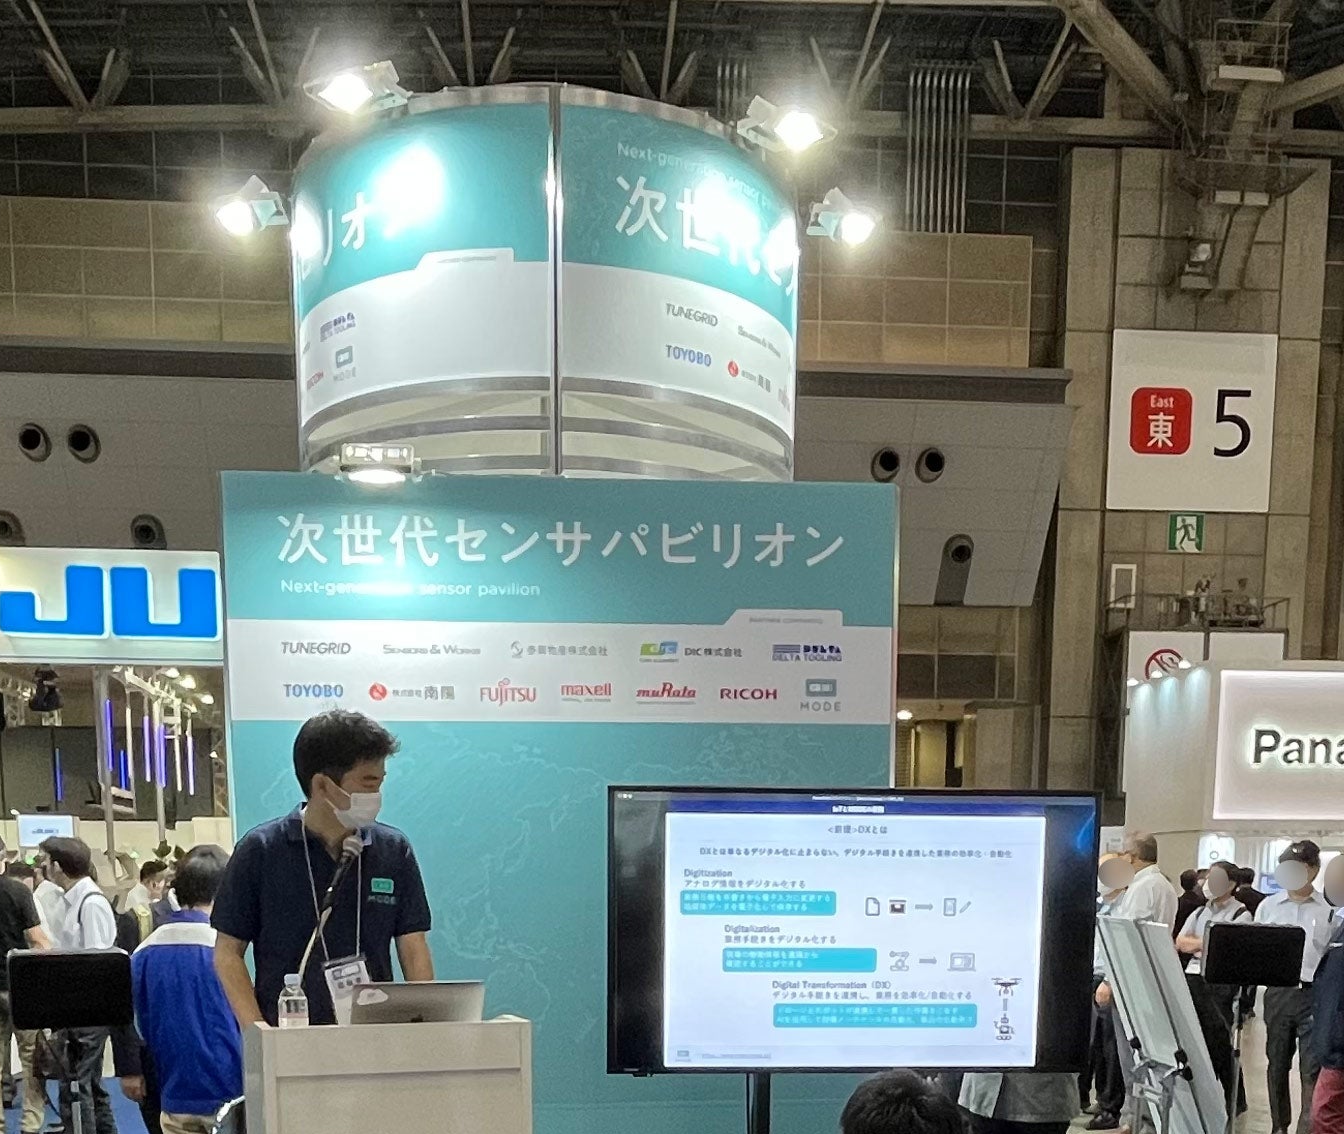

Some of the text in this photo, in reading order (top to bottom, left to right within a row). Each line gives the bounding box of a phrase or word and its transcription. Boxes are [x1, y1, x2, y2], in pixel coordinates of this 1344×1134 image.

[665, 344, 712, 367] TOYOBO
[1150, 394, 1174, 409] East
[1147, 412, 1176, 448] 東
[1213, 389, 1252, 457] 5
[277, 513, 845, 569] 次世代センサパビリオン
[477, 581, 541, 598] pavilion
[280, 641, 352, 656] TUNEGRID
[283, 684, 344, 698] TOYOBO
[560, 682, 612, 697] maxell
[720, 687, 778, 701] RICOH
[800, 701, 842, 712] MODE
